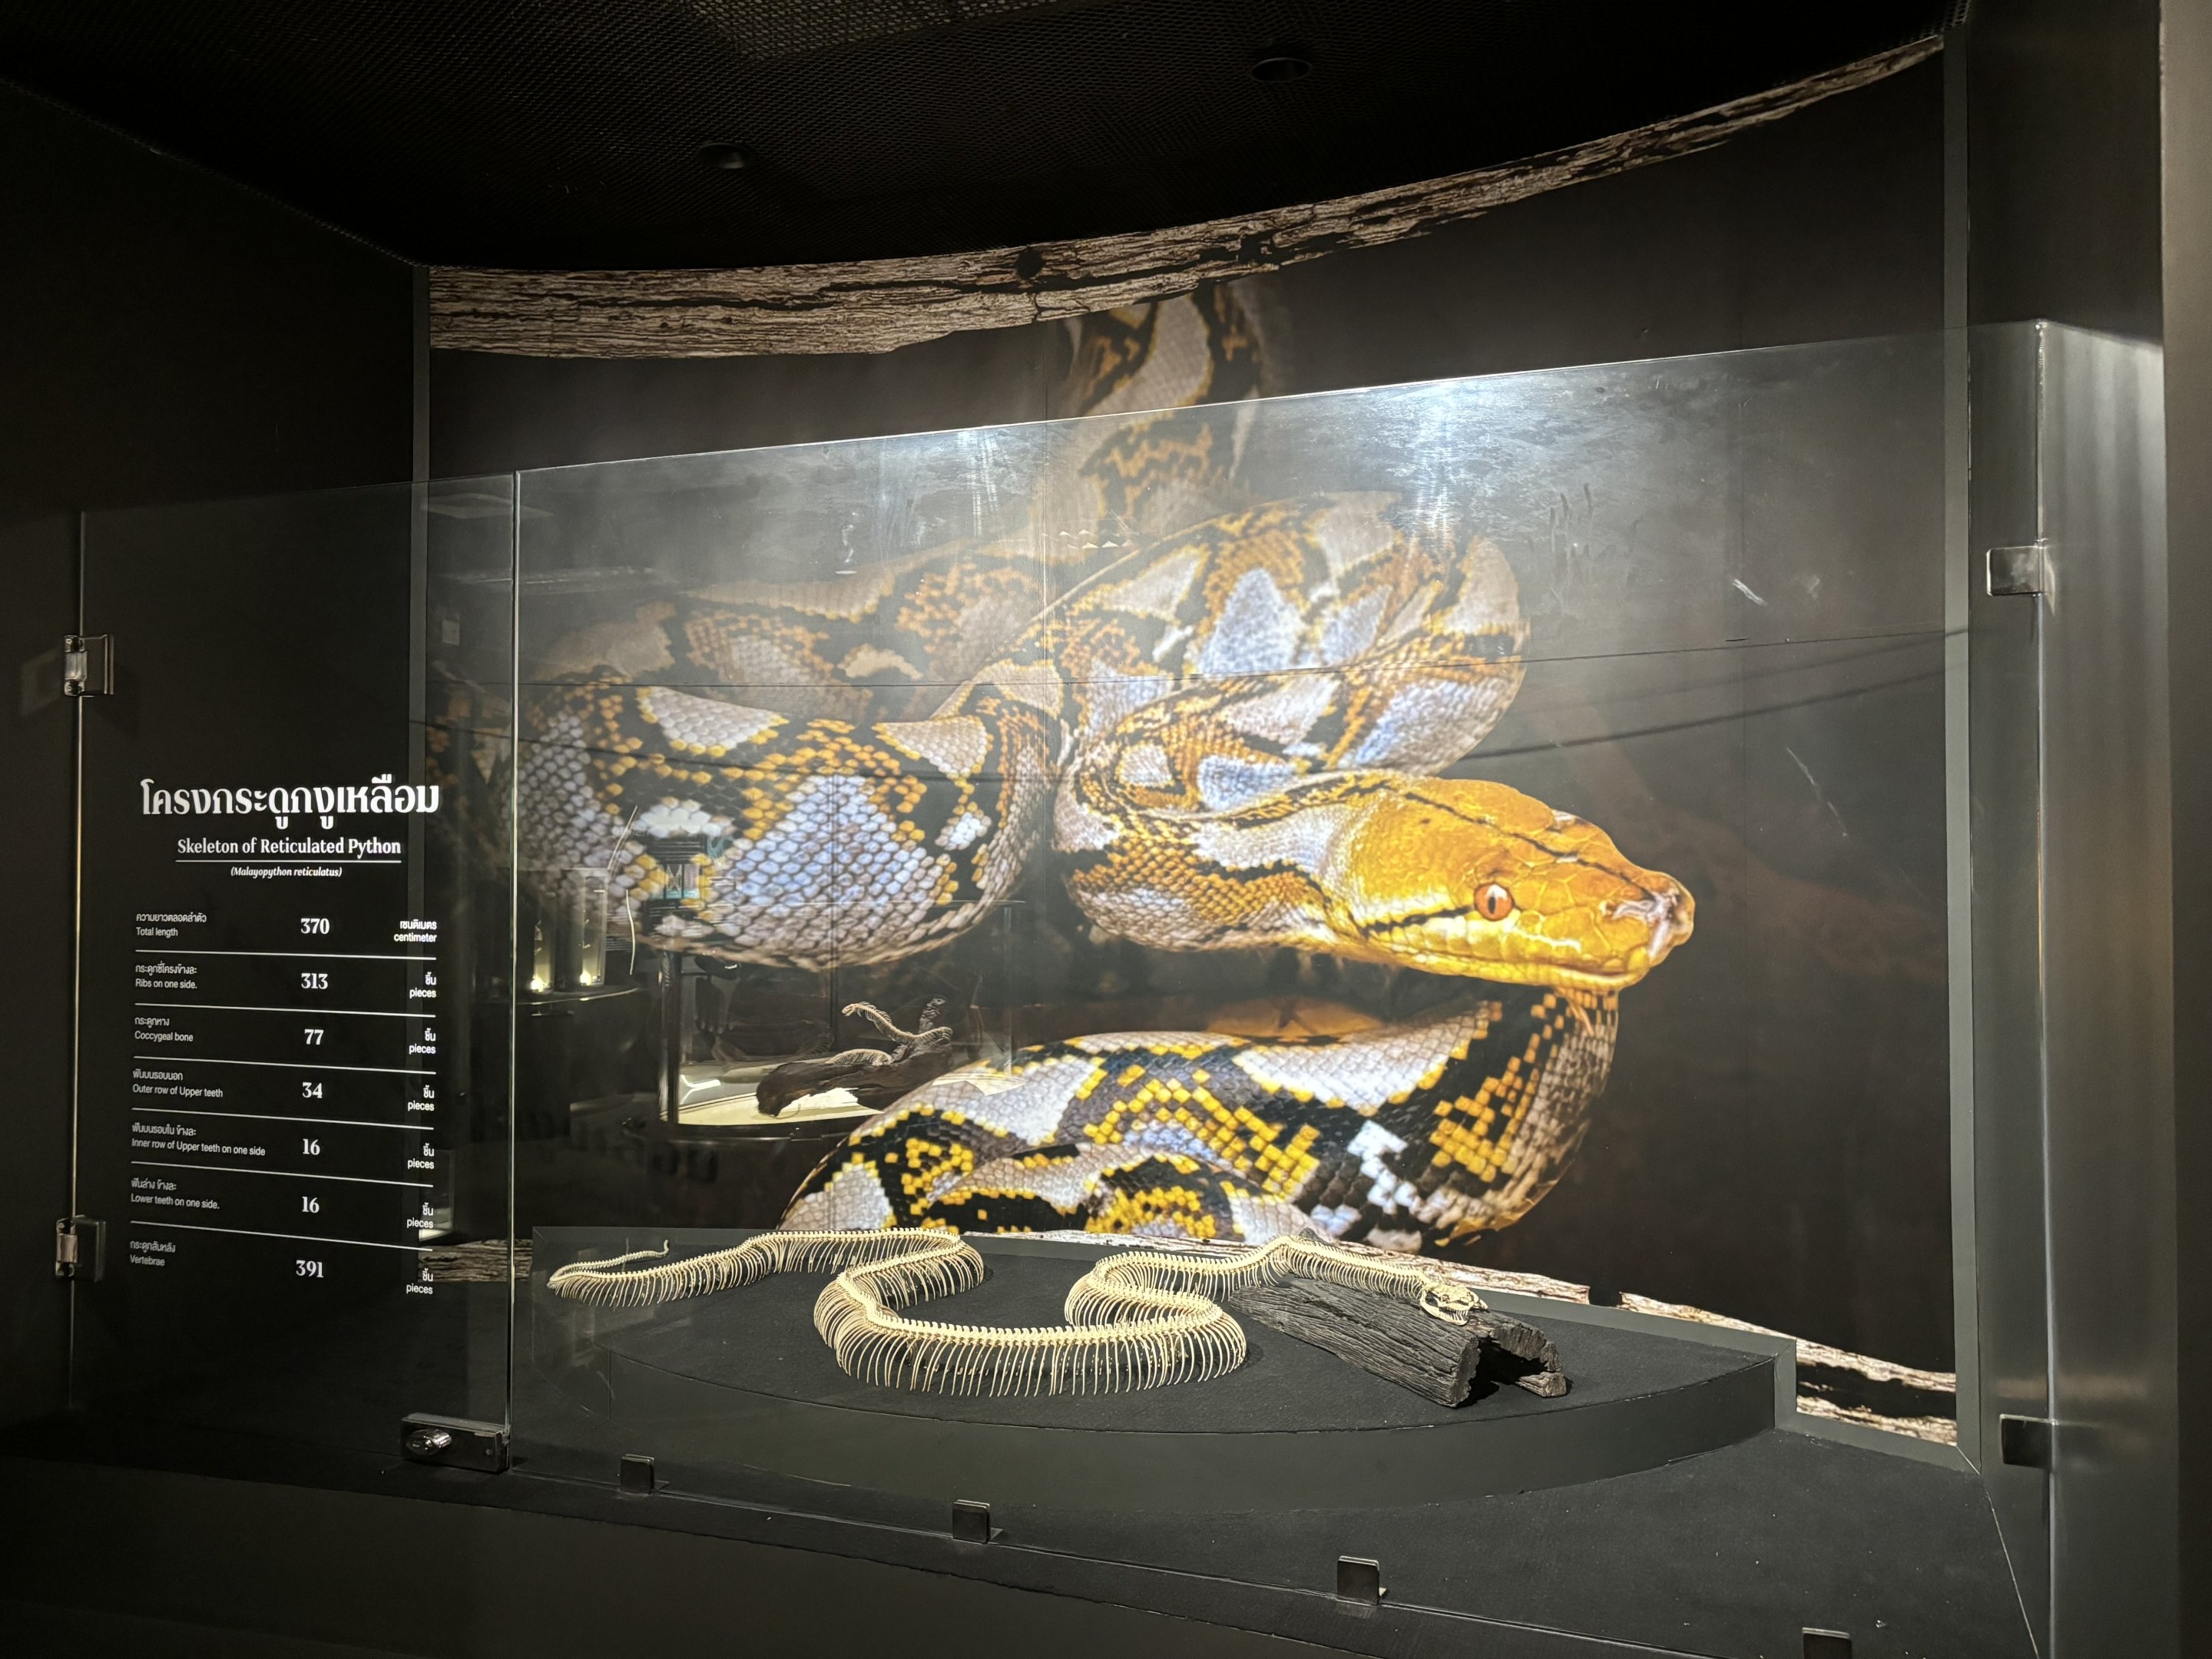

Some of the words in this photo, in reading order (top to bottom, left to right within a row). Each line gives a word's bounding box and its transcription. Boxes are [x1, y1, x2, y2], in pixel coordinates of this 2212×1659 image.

[140, 773, 439, 830] โครงกระดูกงูเหลือม
[177, 837, 239, 854] Skeleton
[241, 836, 257, 854] of
[260, 836, 345, 854] Reticulated
[348, 836, 402, 859] Python
[230, 866, 293, 879] (Malayopython
[293, 866, 343, 878] reticulatus)
[136, 911, 207, 923] ความยาวตลอดลำตัว
[300, 918, 330, 935] 370
[399, 919, 437, 930] เซนติเมตร
[135, 926, 154, 936] Total
[155, 927, 179, 939] length
[393, 932, 438, 942] centimeter
[135, 960, 197, 976] กระดูกซี่โครงข้างละ
[135, 978, 152, 988] Ribs
[164, 980, 179, 988] one
[179, 979, 197, 989] side.
[301, 972, 329, 990] 313
[425, 972, 437, 985] ชิ้น
[409, 987, 437, 999] pieces
[134, 1017, 170, 1028] กระดูกหาง
[134, 1030, 174, 1043] Coccygeal
[174, 1031, 194, 1042] bone
[304, 1028, 324, 1045] 77
[424, 1028, 436, 1041] ชิ้น
[409, 1043, 436, 1055] pieces
[132, 1083, 154, 1094] Outer
[169, 1085, 178, 1095] of
[179, 1086, 201, 1098] Upper
[203, 1088, 224, 1098] teeth
[302, 1081, 323, 1099] 34
[423, 1084, 435, 1099] ชิ้น
[407, 1100, 435, 1111] pieces
[131, 1137, 151, 1147] Inner
[151, 1141, 167, 1149] row
[167, 1140, 175, 1150] of
[176, 1141, 200, 1153] Upper
[200, 1143, 220, 1153] teeth
[221, 1145, 232, 1154] on
[233, 1146, 248, 1155] one
[249, 1145, 266, 1156] side
[303, 1138, 320, 1156] 16
[423, 1143, 435, 1157] ชิ้น
[407, 1157, 435, 1170] pieces
[131, 1193, 154, 1204] Lower
[154, 1195, 174, 1205] teeth
[174, 1198, 185, 1207] on
[185, 1199, 200, 1208] one
[201, 1199, 220, 1210] side.
[302, 1196, 320, 1214] 16
[422, 1202, 434, 1217] ชิ้น
[406, 1217, 434, 1230] pieces
[130, 1254, 165, 1267] Vertebrae
[296, 1260, 324, 1278] 391
[422, 1268, 434, 1282] ชิ้น
[406, 1283, 433, 1295] pieces
